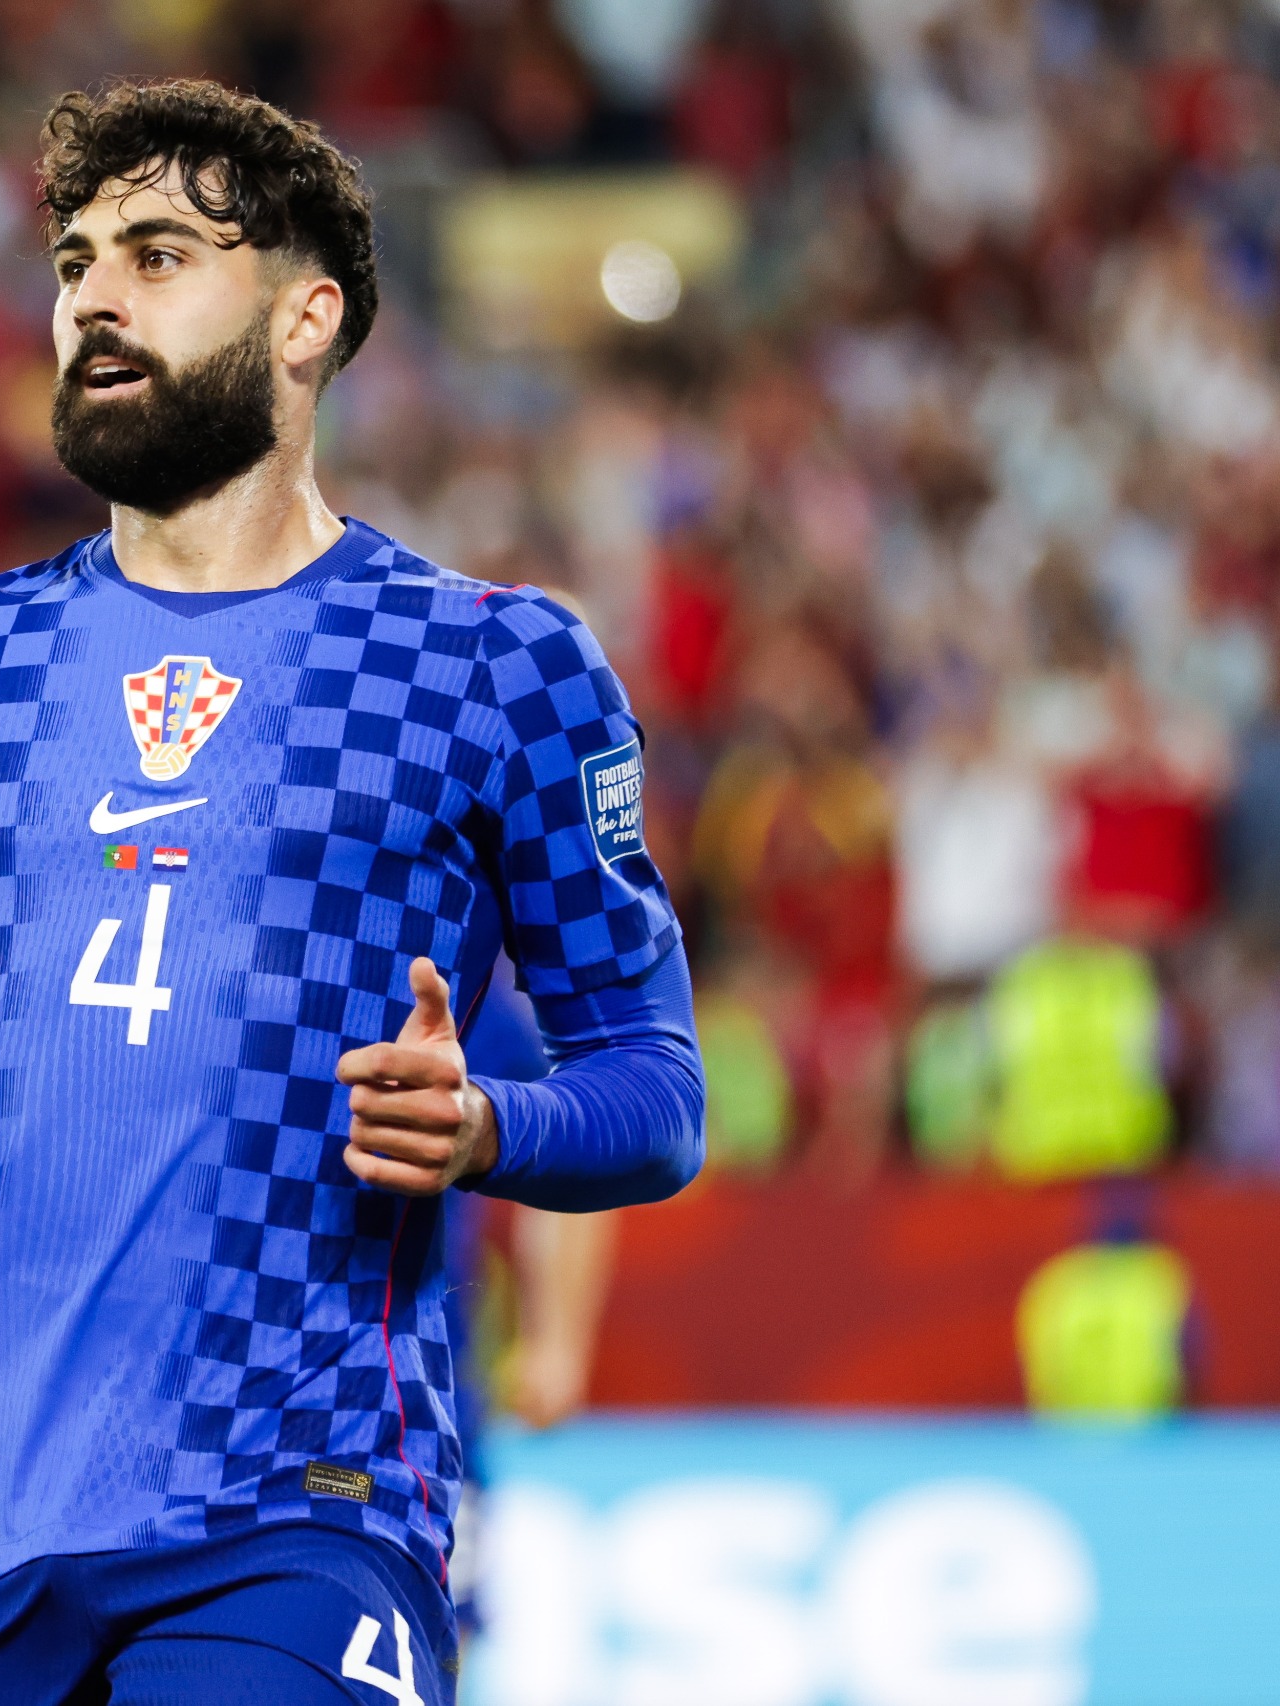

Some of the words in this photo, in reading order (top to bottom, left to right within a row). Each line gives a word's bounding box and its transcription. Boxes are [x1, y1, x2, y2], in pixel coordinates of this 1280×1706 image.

[166, 669, 192, 731] HNS
[595, 757, 640, 789] FOOTBALL
[596, 775, 641, 812] UNITES
[595, 813, 617, 836] the
[613, 829, 638, 844] FIFA
[69, 883, 172, 1046] 4
[341, 1607, 425, 1706] 4
